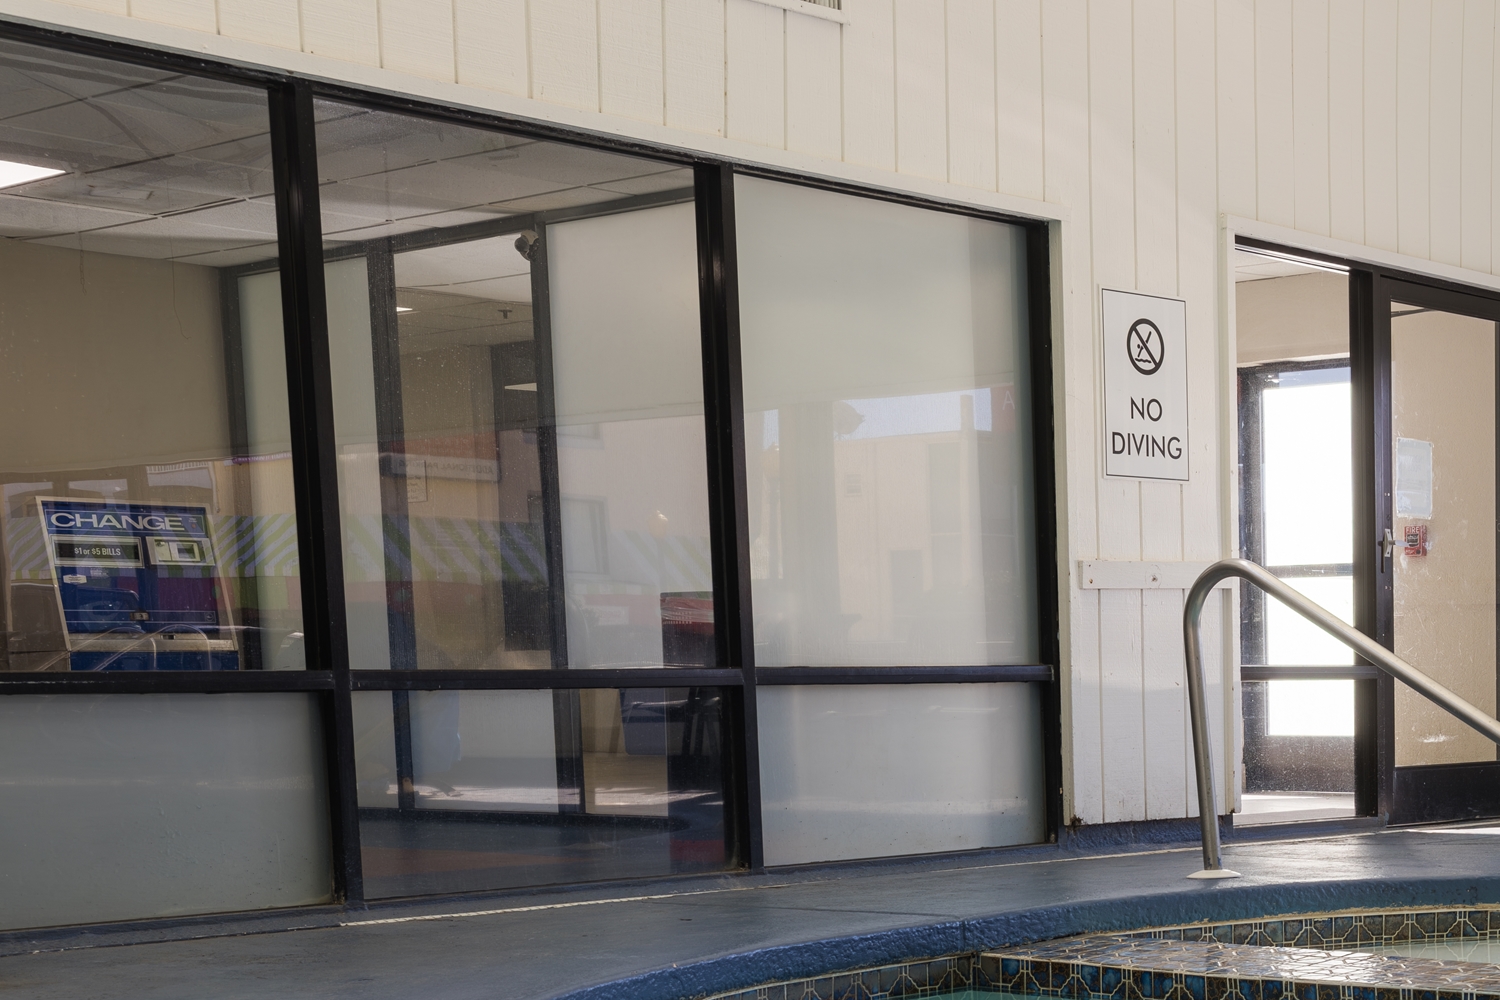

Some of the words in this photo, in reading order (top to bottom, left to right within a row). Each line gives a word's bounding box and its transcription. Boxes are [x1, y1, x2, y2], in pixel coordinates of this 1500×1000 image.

[1130, 396, 1163, 422] NO
[1111, 431, 1182, 460] DIVING
[50, 512, 185, 531] CHANGE
[1405, 526, 1420, 534] FIRE
[74, 547, 82, 555] $1
[91, 547, 101, 556] $5
[101, 547, 121, 556] BILLS
